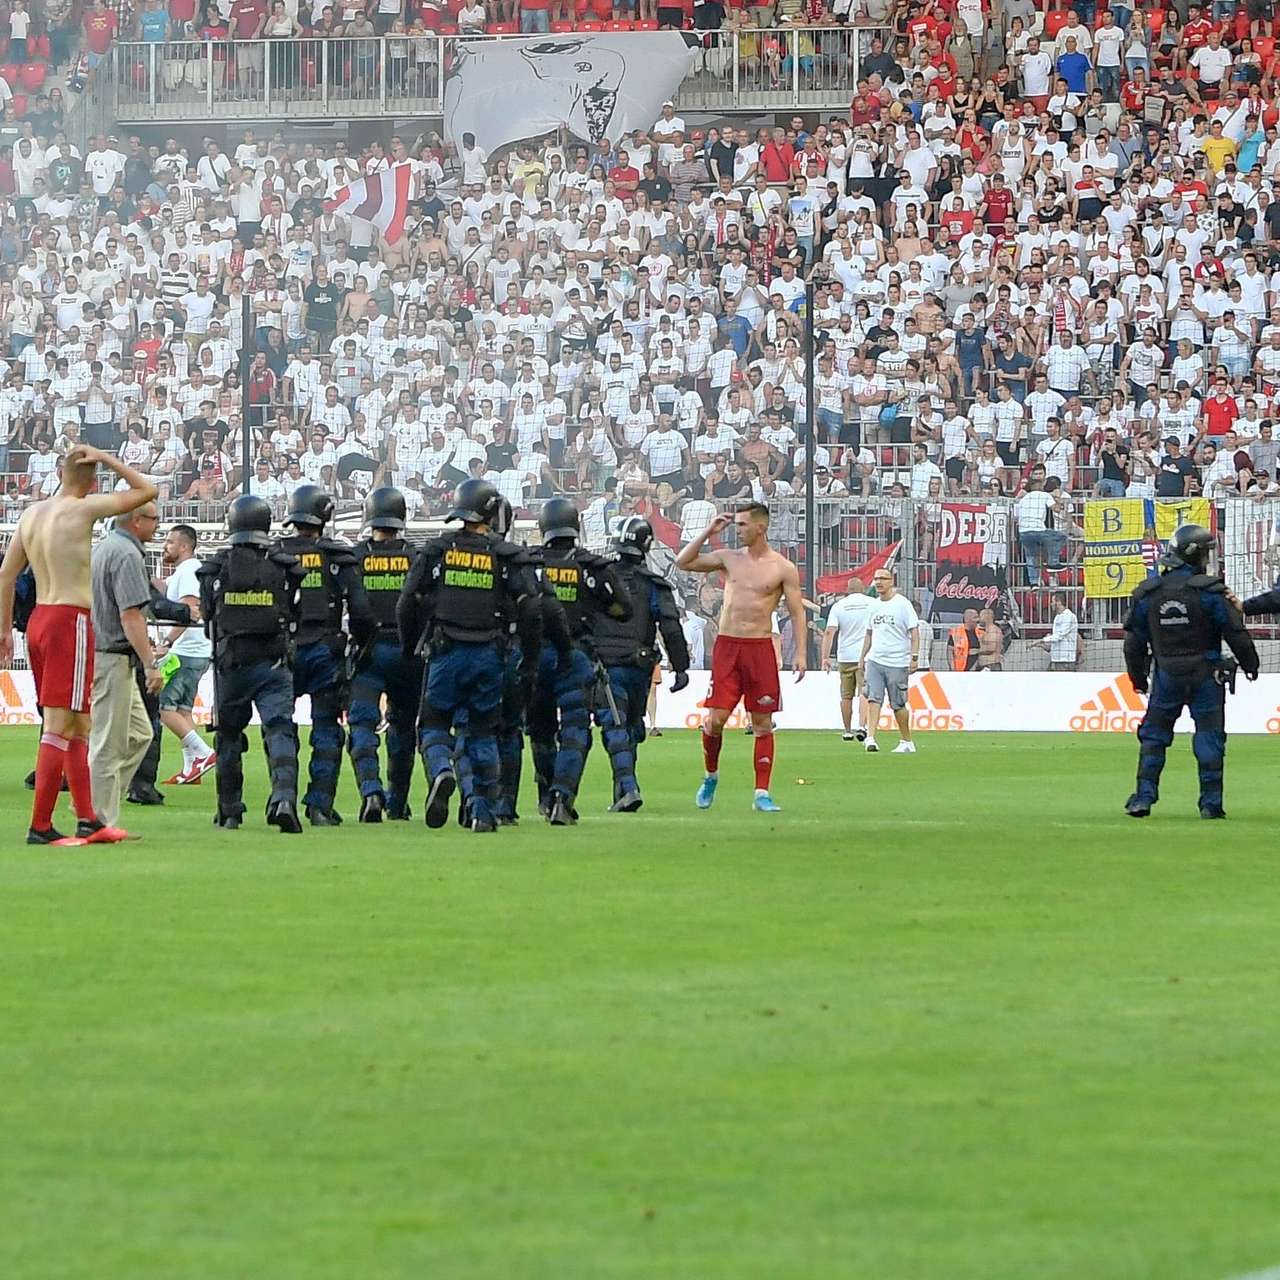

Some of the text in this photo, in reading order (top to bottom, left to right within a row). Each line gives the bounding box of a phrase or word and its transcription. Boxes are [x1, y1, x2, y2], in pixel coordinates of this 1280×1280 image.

[1103, 507, 1123, 533] B
[364, 555, 409, 571] CÍVIS KTA
[445, 548, 492, 570] CÍVIS KTA
[444, 569, 494, 589] RENDŐRSÉG
[1106, 562, 1123, 591] 9
